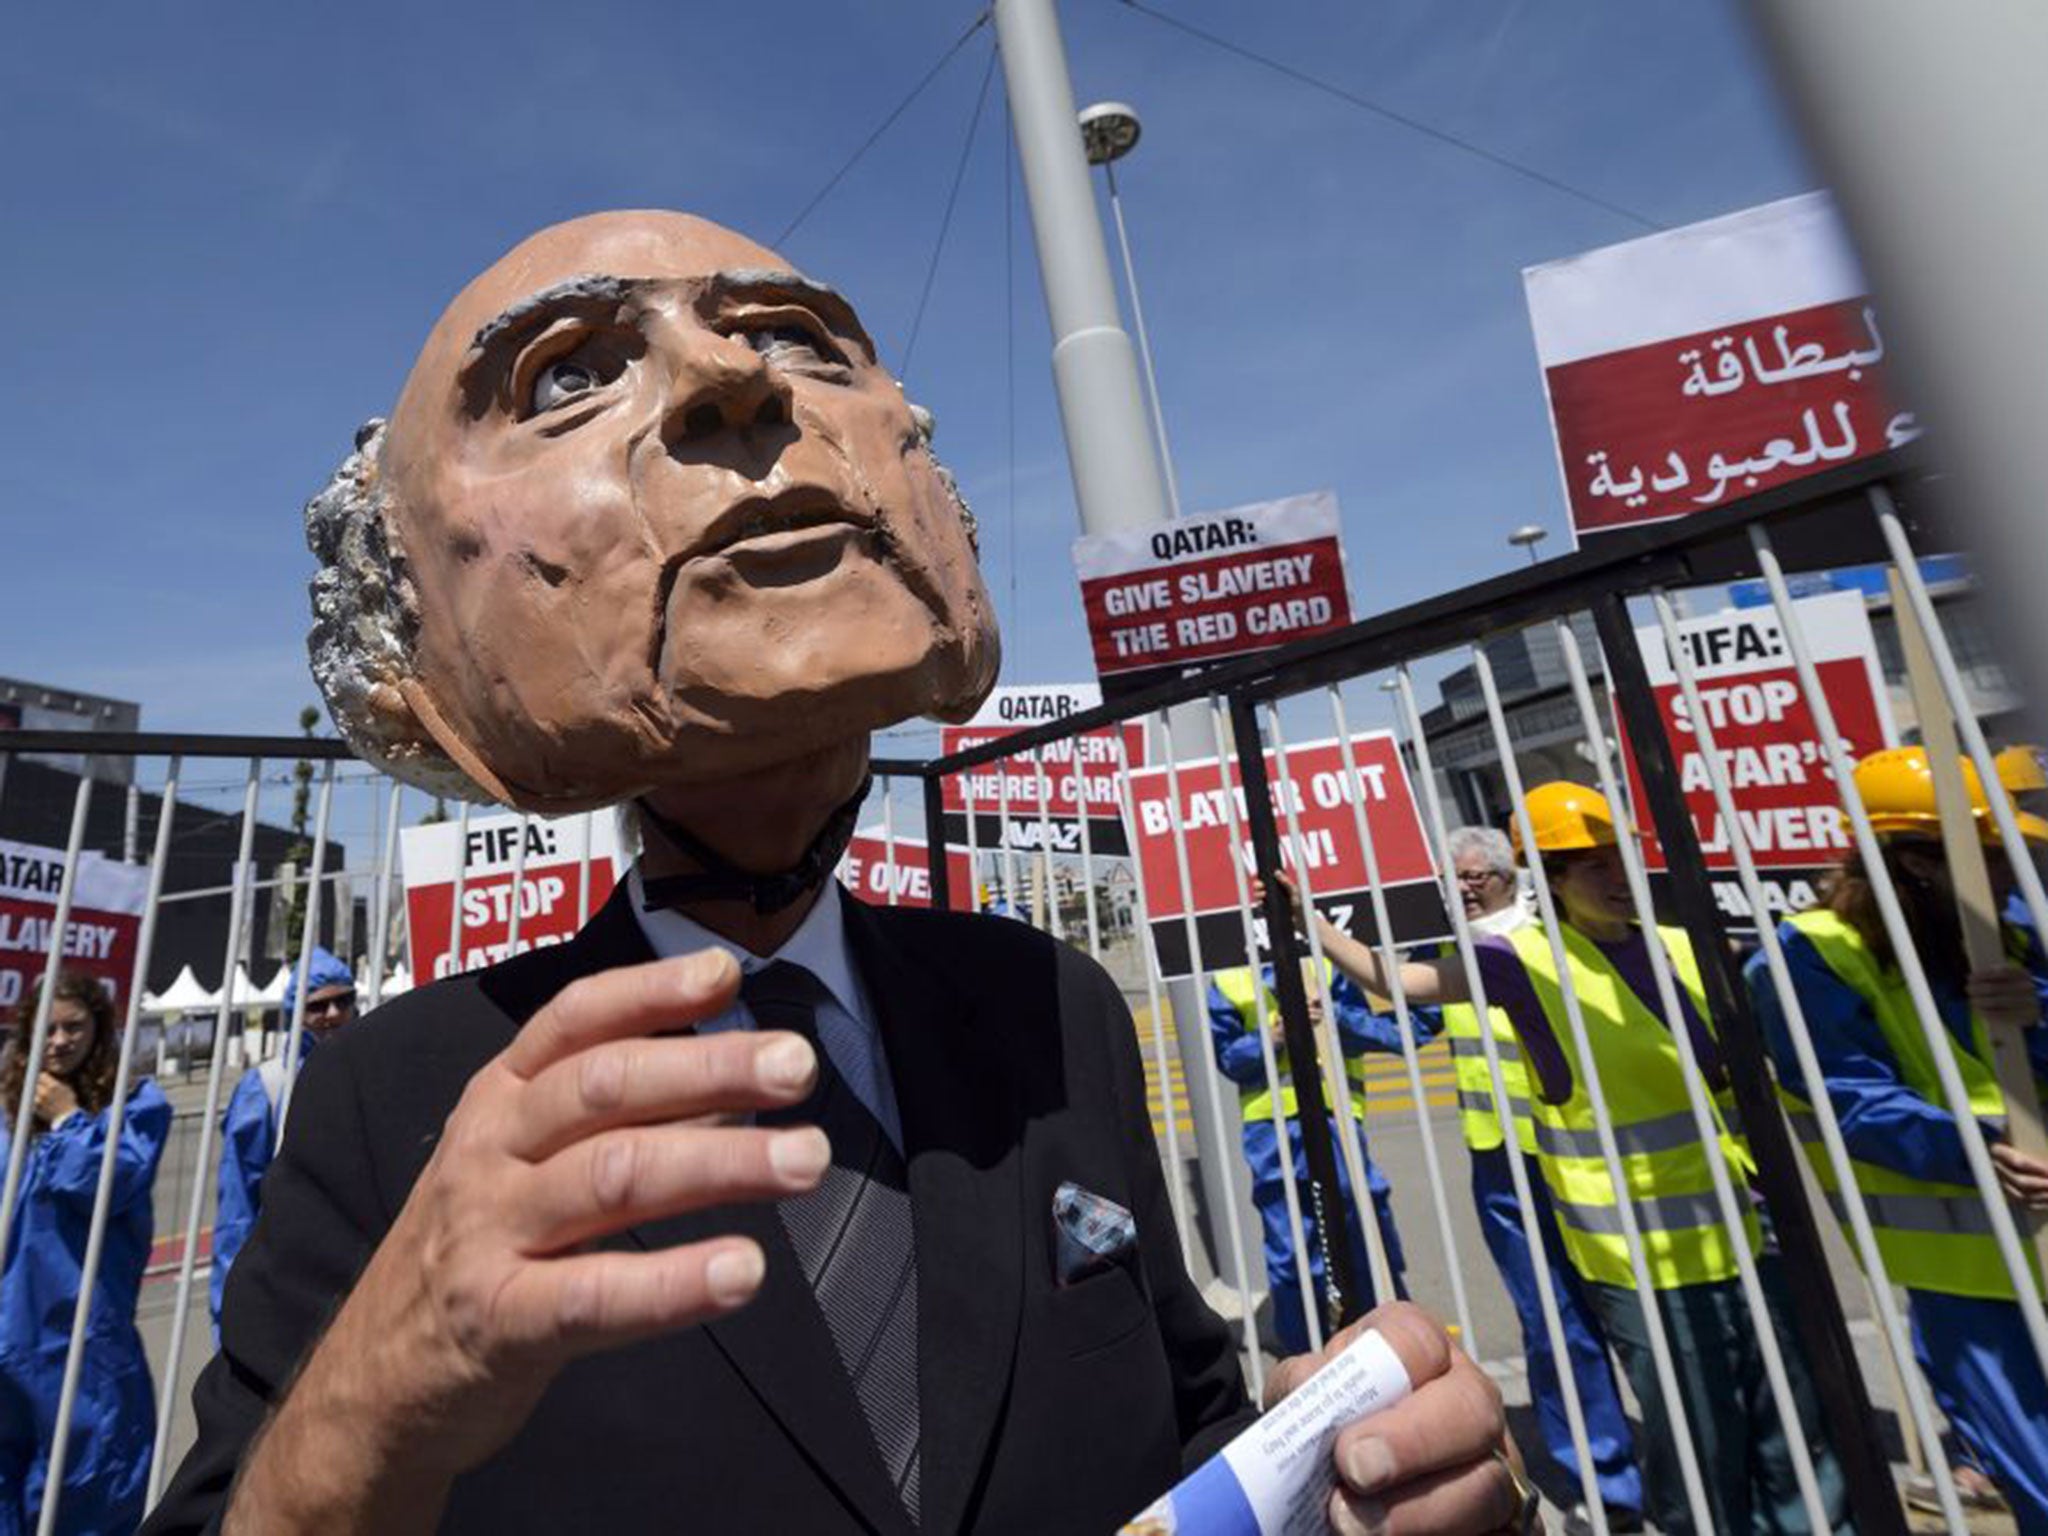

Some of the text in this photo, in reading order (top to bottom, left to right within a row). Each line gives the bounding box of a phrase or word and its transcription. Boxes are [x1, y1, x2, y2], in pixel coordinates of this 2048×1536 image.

[1586, 401, 1857, 507] للعبودية
[1152, 519, 1257, 560] QATAR:
[1104, 554, 1314, 617] GIVE SLAVERY
[1111, 597, 1332, 657] THE RED CARD
[1670, 680, 1798, 733] STOP
[956, 775, 1000, 801] THE
[1006, 775, 1054, 801] RED
[1311, 764, 1387, 809] OUT
[1680, 737, 1858, 793] ATAR'S
[465, 824, 556, 867] FIFA:
[1229, 829, 1338, 876] NW!
[1690, 805, 1853, 854] LAVER
[463, 876, 565, 928] STOP
[870, 861, 932, 899] OVE
